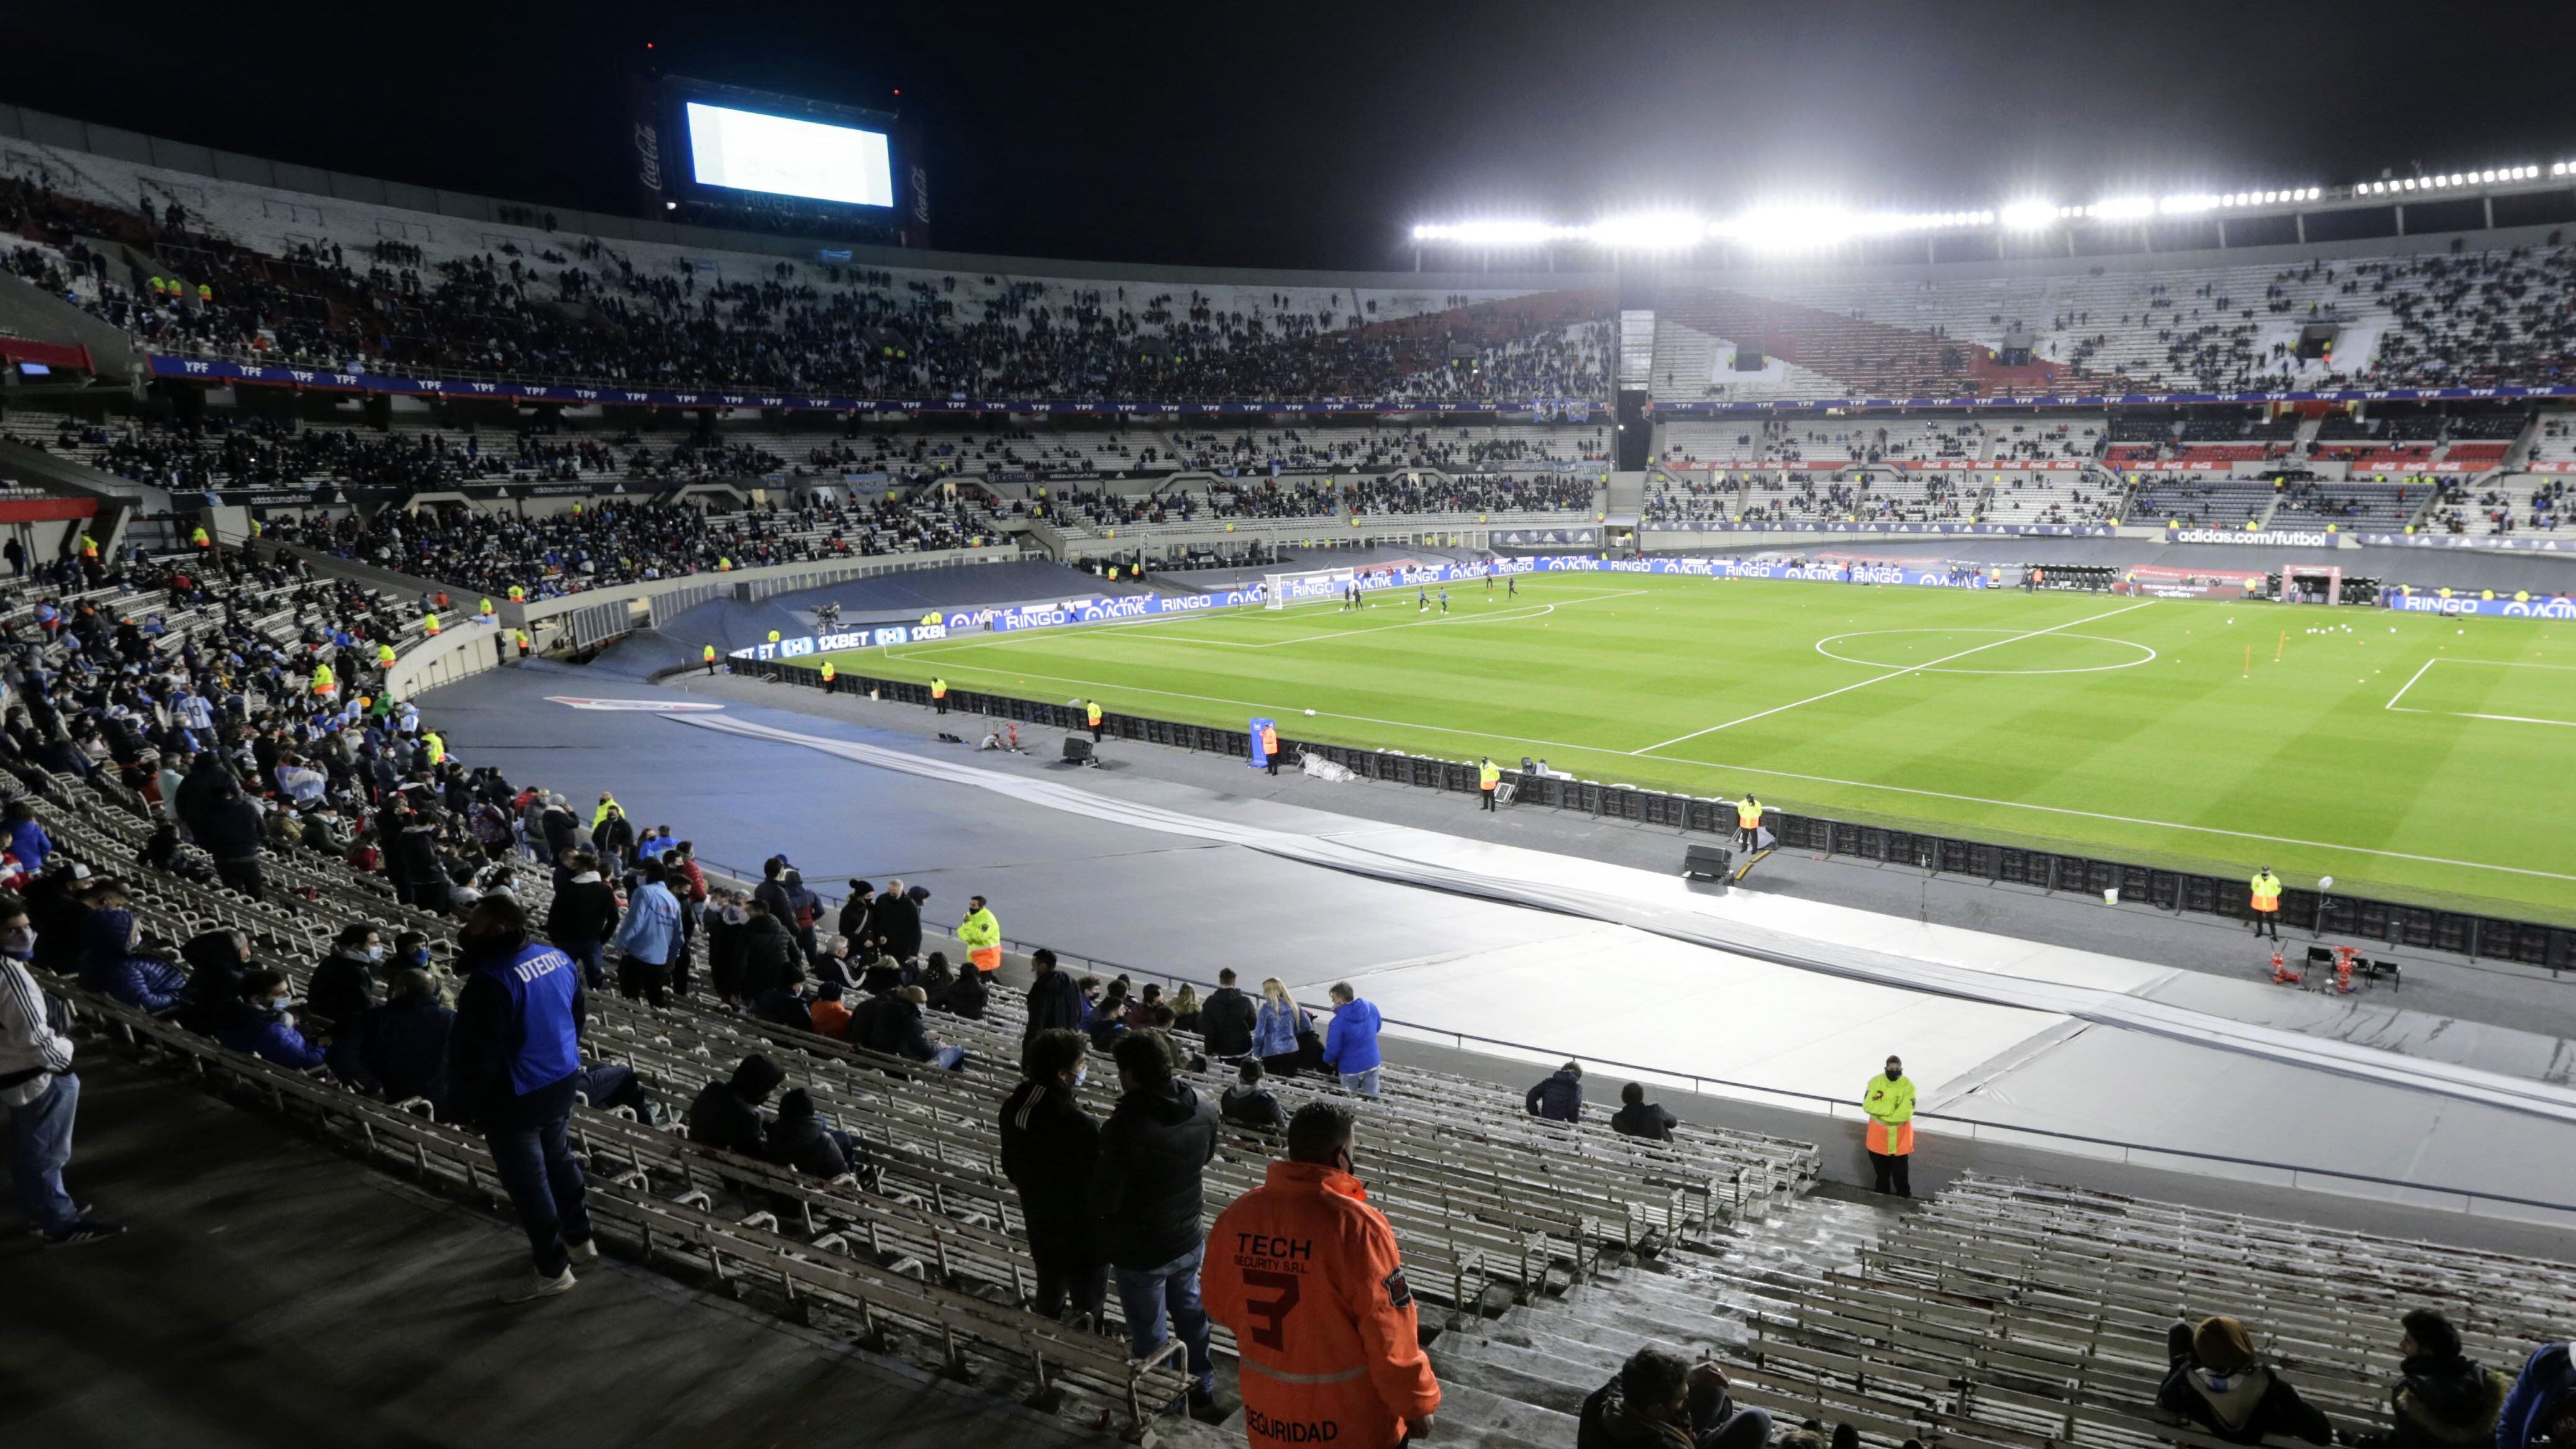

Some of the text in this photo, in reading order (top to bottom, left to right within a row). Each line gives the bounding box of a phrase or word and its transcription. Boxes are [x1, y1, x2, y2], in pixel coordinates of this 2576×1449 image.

[184, 361, 209, 373] YPF
[239, 366, 262, 376] YPF
[291, 371, 314, 381] YPF
[334, 374, 357, 384] YPF
[418, 381, 442, 390] YPF
[472, 383, 495, 392] YPF
[524, 386, 547, 396] YPF
[575, 389, 598, 399] YPF
[626, 393, 647, 401] YPF
[676, 395, 698, 403] YPF
[856, 401, 876, 409] YPF
[2526, 387, 2554, 395] YPF
[2178, 530, 2326, 546] adidas.com/futbol
[1498, 562, 1534, 573] RINGO
[1567, 561, 1599, 570] ACTIVE
[1611, 561, 1651, 572] RINGO
[1680, 564, 1713, 575] ACTIVE
[1726, 566, 1770, 577] RINGO
[1403, 571, 1439, 584] RINGO
[1802, 568, 1839, 581] ACTIVE
[1854, 571, 1903, 583] RINGO
[1363, 575, 1392, 589] ACTIVE
[1293, 583, 1334, 597] RINGO
[1105, 602, 1146, 617] ACTIVE
[1162, 595, 1211, 612] RINGO
[2405, 596, 2478, 613] RINGO
[1006, 611, 1065, 629] RINGO
[818, 631, 869, 651] 1XBET
[514, 950, 568, 983] UTEDYC
[1237, 1232, 1312, 1260] TECH
[1234, 1255, 1279, 1271] SECURITY
[1245, 1404, 1338, 1443] SEGURIDAD
